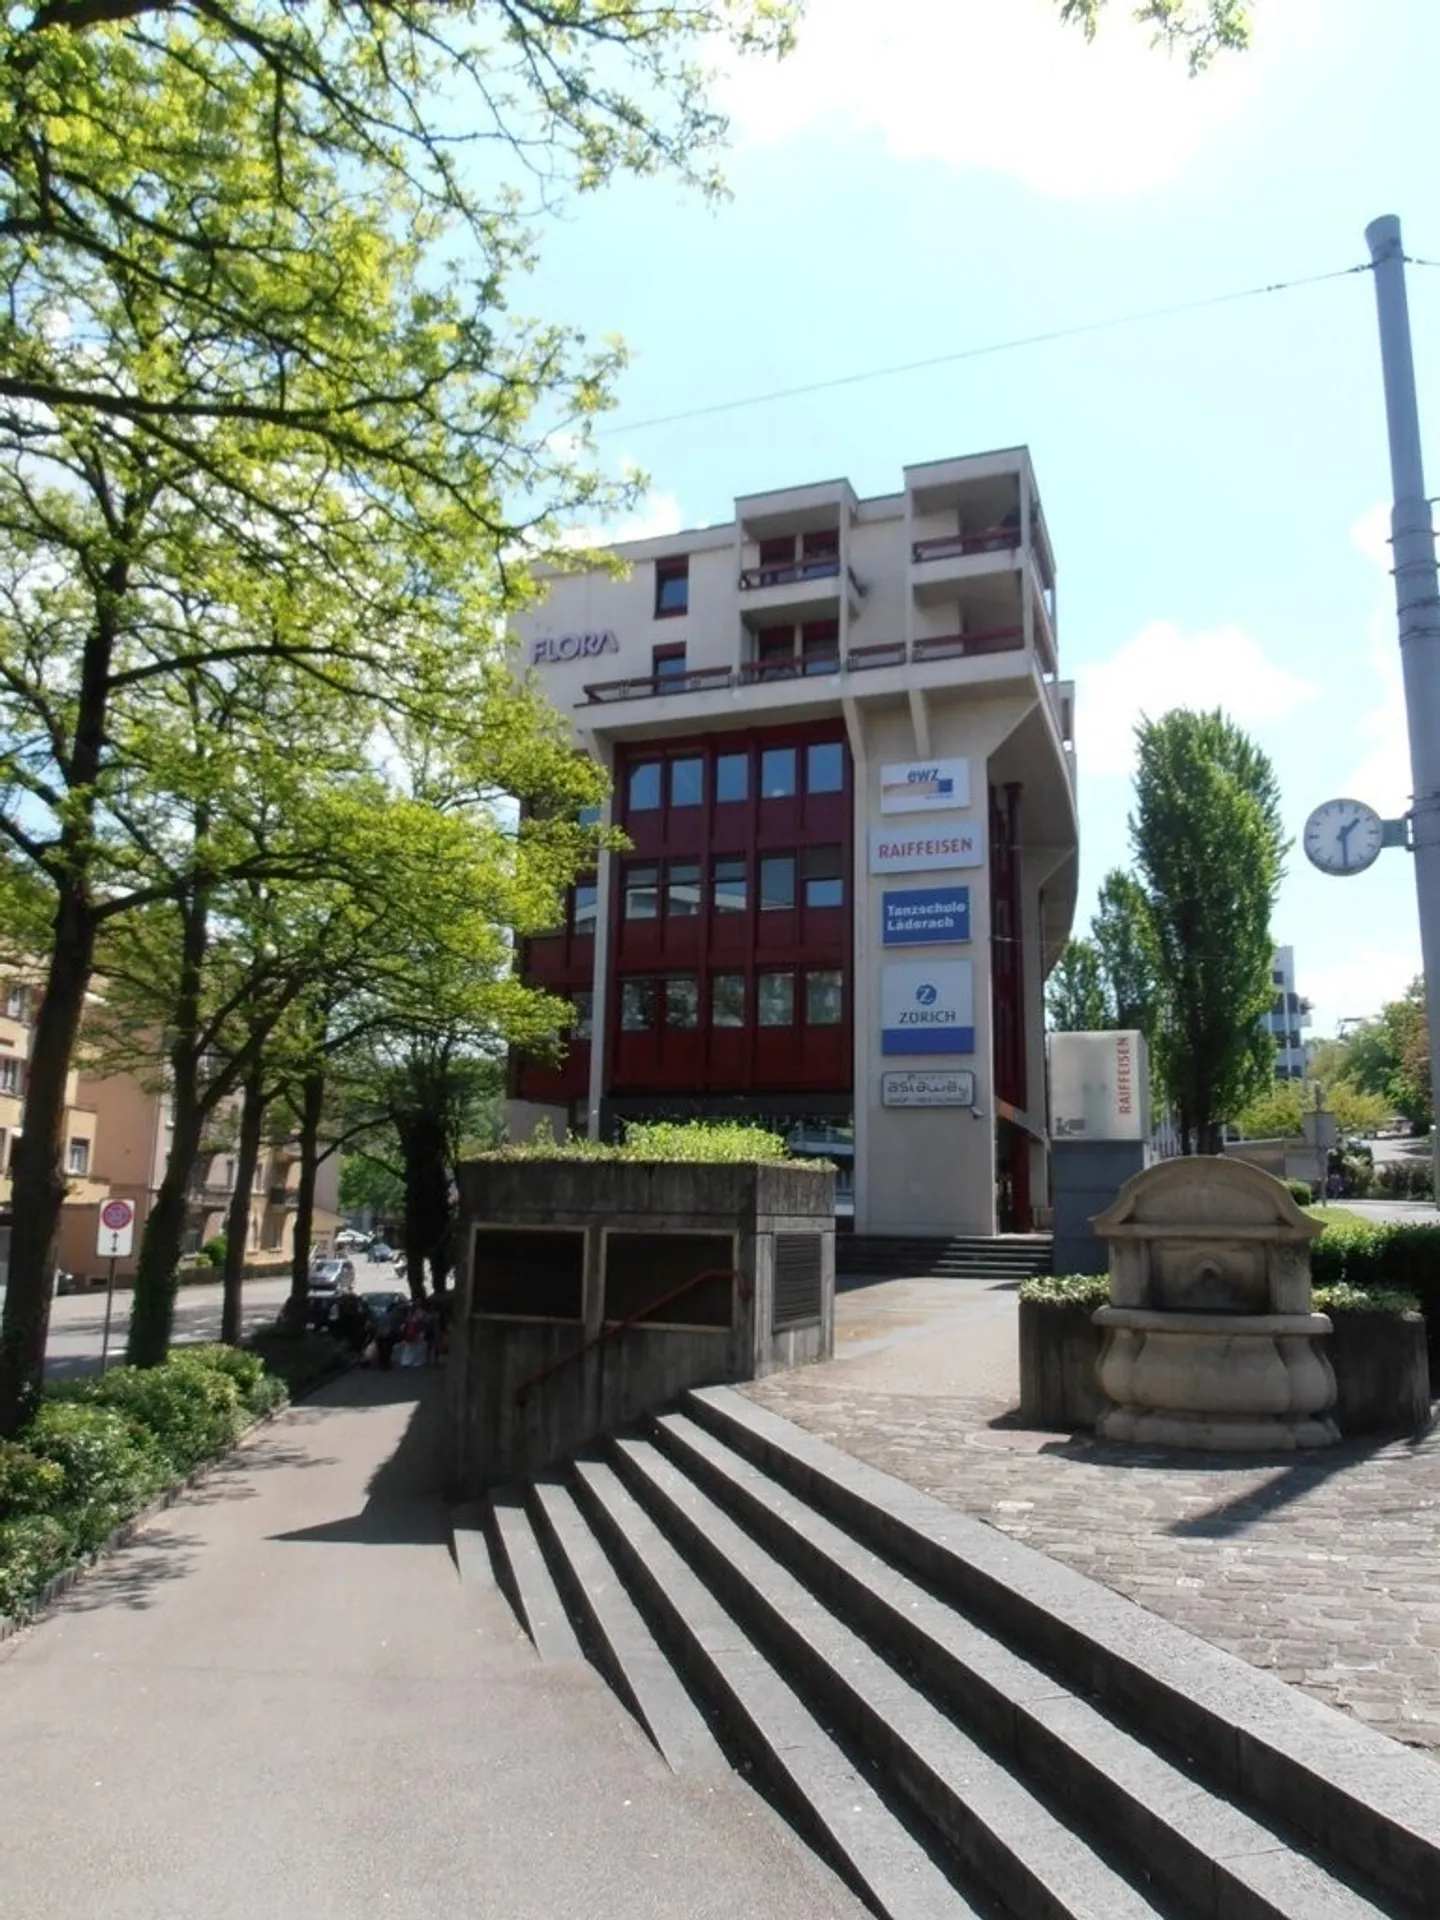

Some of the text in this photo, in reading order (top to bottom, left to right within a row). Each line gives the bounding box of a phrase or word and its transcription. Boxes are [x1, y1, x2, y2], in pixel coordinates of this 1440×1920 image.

[530, 629, 619, 664] FLORA
[907, 768, 939, 783] ewz
[879, 836, 973, 859] RAIFFEISEN
[887, 901, 966, 917] Tanzschule
[1116, 1036, 1132, 1114] RAIFFEISEN
